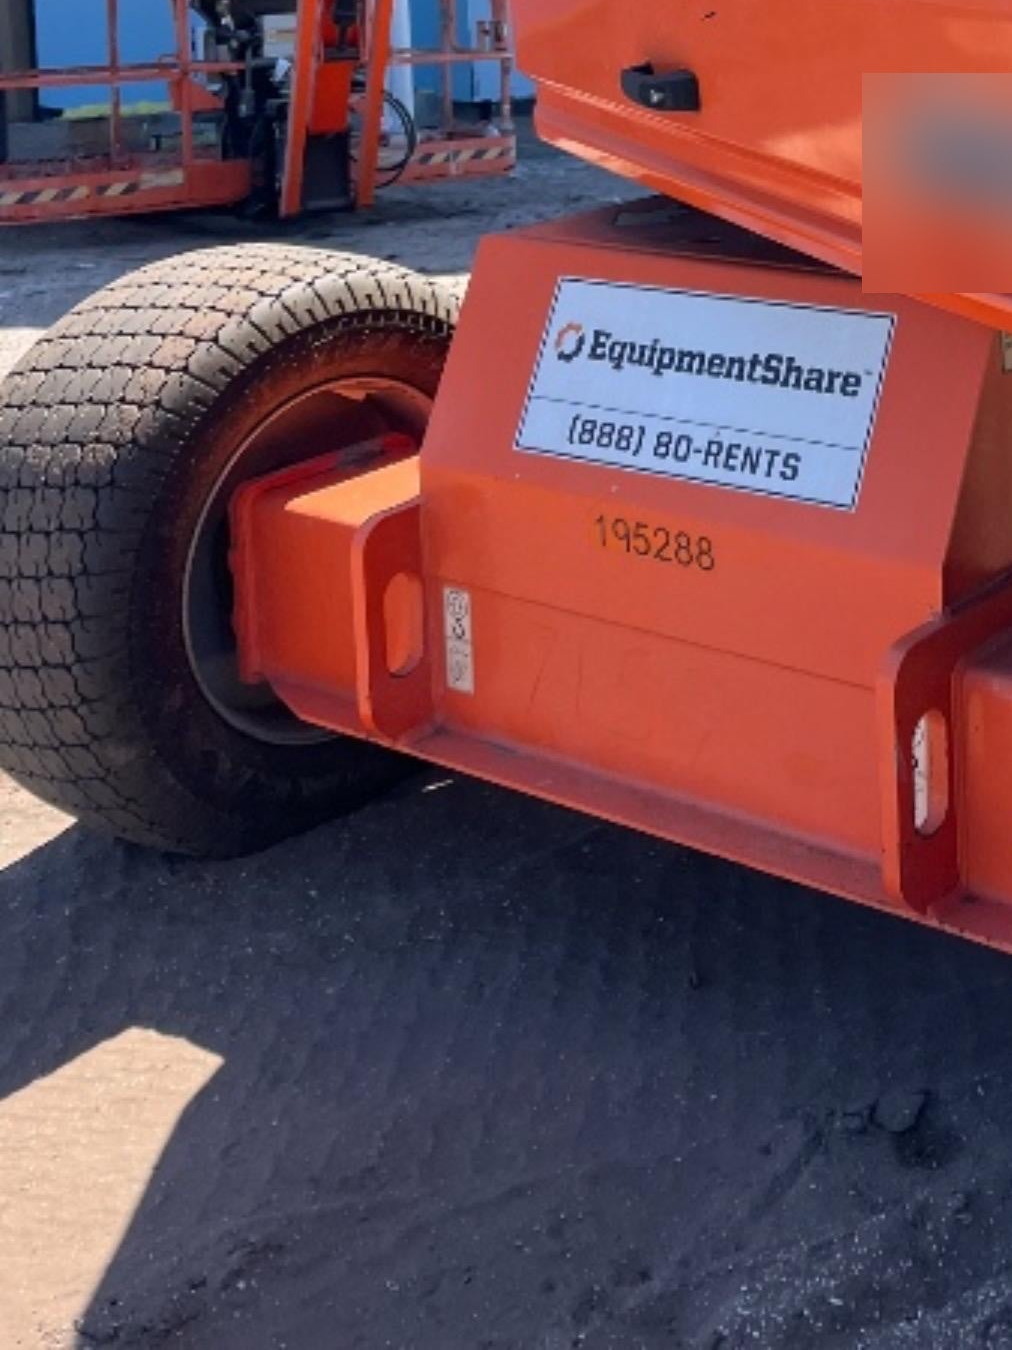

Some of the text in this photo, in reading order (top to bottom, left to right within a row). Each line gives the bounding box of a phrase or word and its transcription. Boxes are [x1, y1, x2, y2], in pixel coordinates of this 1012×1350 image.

[588, 329, 863, 398] EquipmentShare
[567, 413, 802, 482] (888) 80-RENTS
[594, 514, 716, 572] 195288
